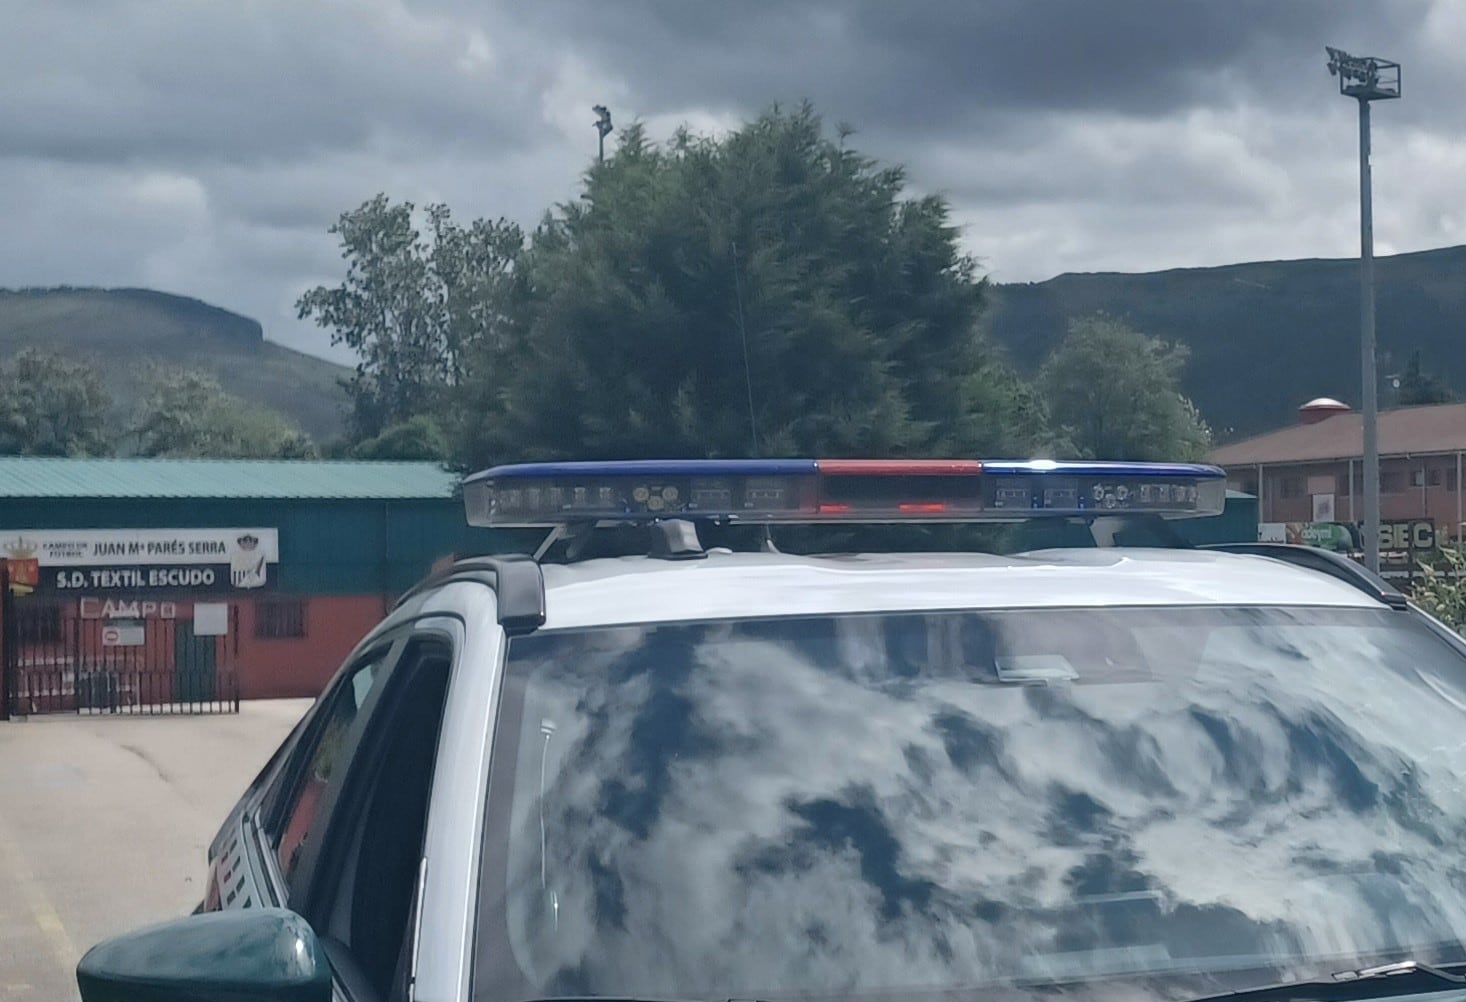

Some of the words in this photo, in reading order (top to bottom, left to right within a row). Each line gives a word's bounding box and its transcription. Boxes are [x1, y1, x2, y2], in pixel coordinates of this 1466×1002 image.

[93, 543, 127, 557] JUAN
[148, 539, 186, 555] PARÉS
[189, 540, 226, 554] SERRA
[57, 572, 88, 589] S.D.
[91, 570, 146, 588] TEXTIL
[150, 568, 215, 586] ESCUDO
[80, 597, 176, 619] CAMPO
